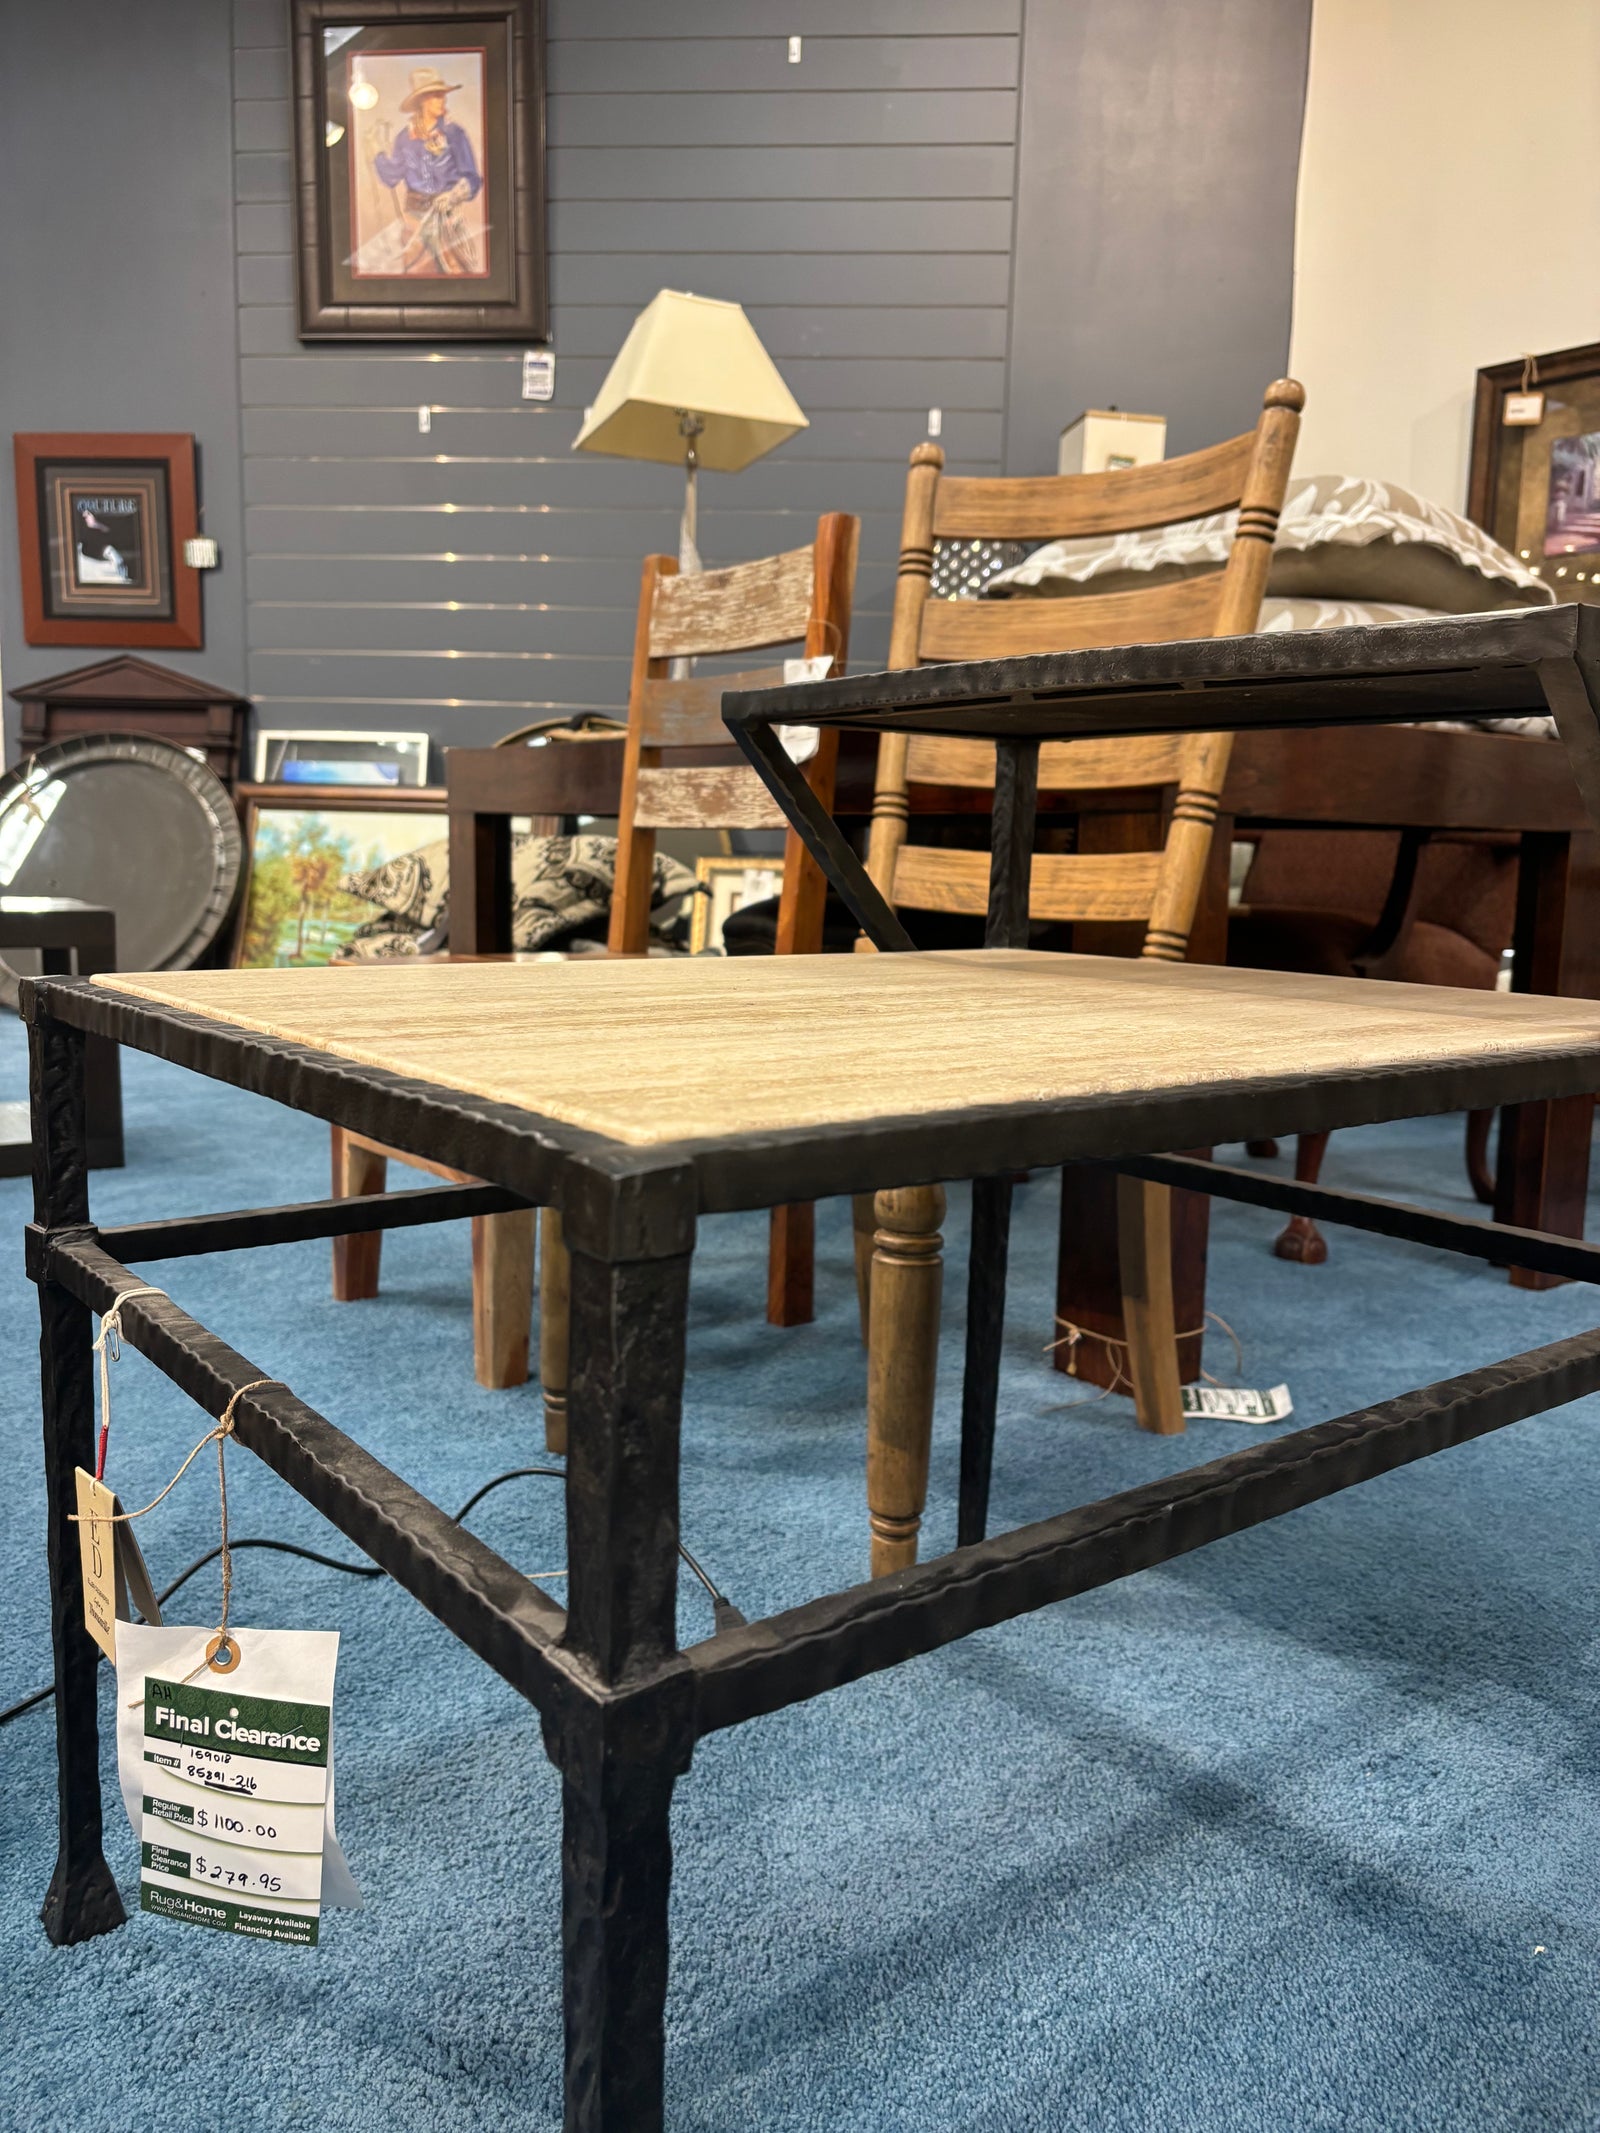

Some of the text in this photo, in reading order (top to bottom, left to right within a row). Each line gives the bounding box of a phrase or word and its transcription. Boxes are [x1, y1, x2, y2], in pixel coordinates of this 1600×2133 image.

[155, 1706, 321, 1752] Final Clearance
[153, 1754, 172, 1766] Item
[152, 1799, 181, 1812] Regular
[152, 1808, 193, 1824] Retail Price
[151, 1845, 169, 1857] Final
[151, 1853, 188, 1869] Clearance
[151, 1862, 170, 1873] Price
[150, 1891, 227, 1919] Rug&Home
[239, 1911, 311, 1930] Layaway Available
[234, 1923, 310, 1942] Financing Available
